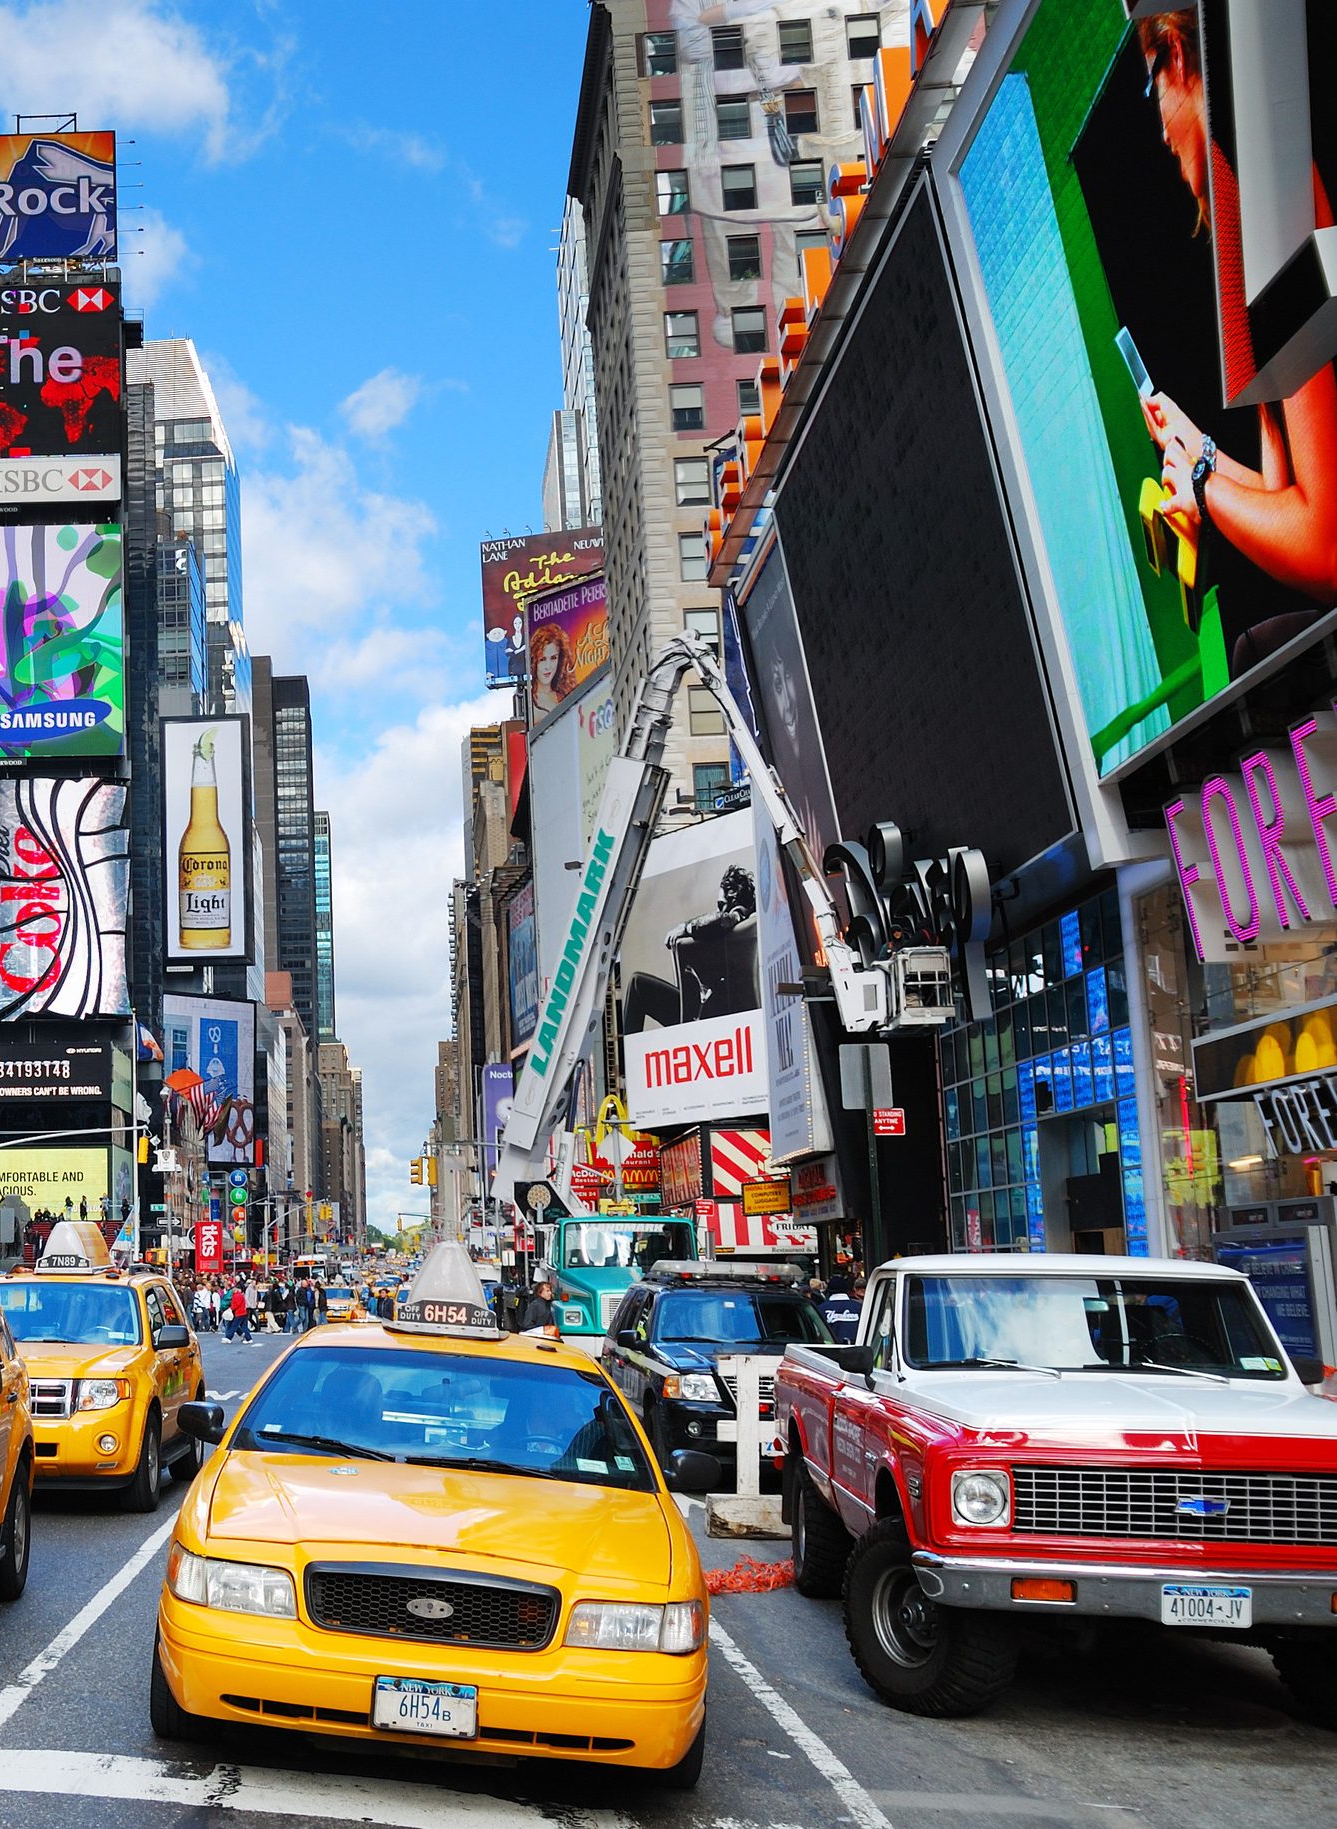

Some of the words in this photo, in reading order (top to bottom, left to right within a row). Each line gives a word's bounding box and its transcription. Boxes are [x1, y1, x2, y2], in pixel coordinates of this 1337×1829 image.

[481, 538, 526, 553] NATHAN
[482, 550, 509, 563] LANE
[529, 551, 577, 570] The
[533, 592, 580, 623] BERNADETTE
[0, 712, 96, 729] SAMSUNG
[181, 855, 229, 875] Corona
[185, 892, 226, 914] Light
[530, 827, 617, 1079] LANDMARK
[644, 1025, 754, 1089] maxell
[0, 1087, 33, 1097] OWNERS
[34, 1087, 57, 1096] CAN'T
[58, 1086, 70, 1096] BE
[70, 1085, 103, 1096] WRONG.
[61, 1171, 85, 1182] AND
[750, 1191, 782, 1199] COMPUTERS
[201, 1223, 216, 1258] tkts
[51, 1256, 76, 1267] 7N89
[1263, 1286, 1290, 1299] CHANGING
[1290, 1285, 1306, 1299] WHAT
[400, 1312, 421, 1321] DUTY
[471, 1317, 492, 1326] DUTY
[404, 1305, 420, 1313] OFF
[424, 1304, 468, 1324] 6H54
[474, 1310, 489, 1318] OFF
[824, 1309, 859, 1323] Yankees
[401, 1682, 424, 1694] NEW
[425, 1684, 454, 1696] YORK
